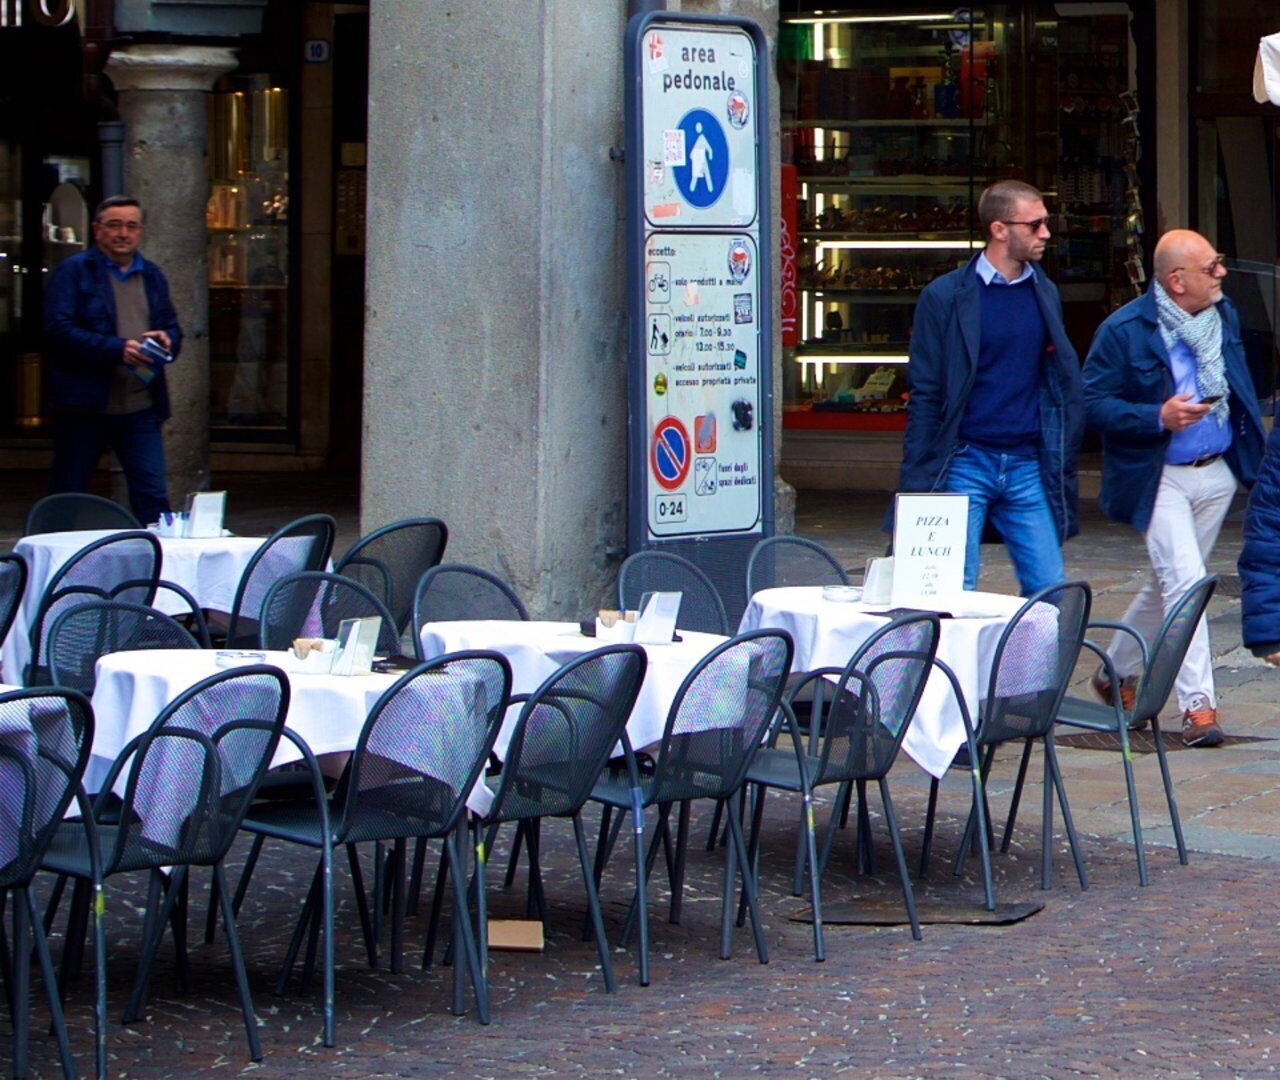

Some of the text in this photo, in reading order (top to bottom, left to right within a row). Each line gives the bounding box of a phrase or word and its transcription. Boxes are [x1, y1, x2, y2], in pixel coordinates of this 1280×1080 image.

[310, 44, 321, 58] 10
[681, 46, 715, 63] area
[663, 69, 735, 93] pedonale
[659, 501, 683, 516] 0-24
[916, 516, 949, 527] PIZZA
[928, 531, 937, 542] E
[910, 546, 951, 557] LUNCH
